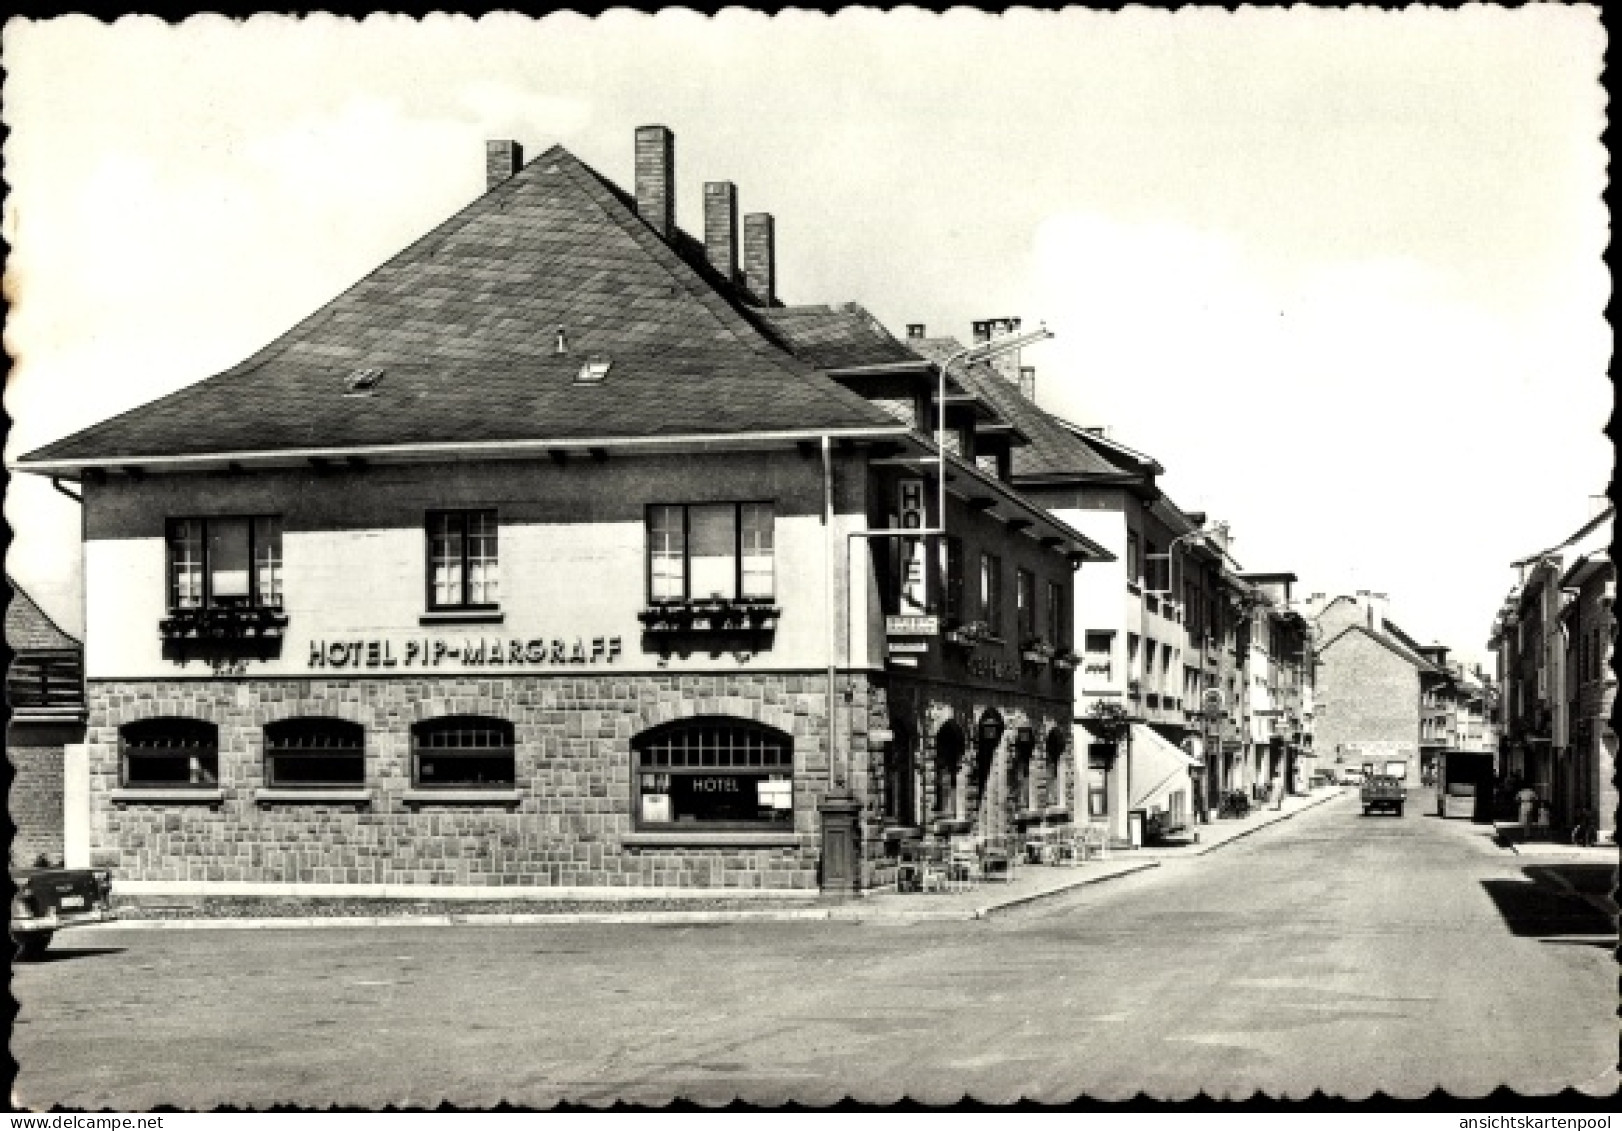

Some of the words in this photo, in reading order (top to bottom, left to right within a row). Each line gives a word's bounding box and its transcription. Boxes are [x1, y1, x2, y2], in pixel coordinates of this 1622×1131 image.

[308, 640, 397, 668] HOTEL
[403, 636, 622, 667] PIP-MARGRAFF
[693, 776, 740, 792] HOTEL
